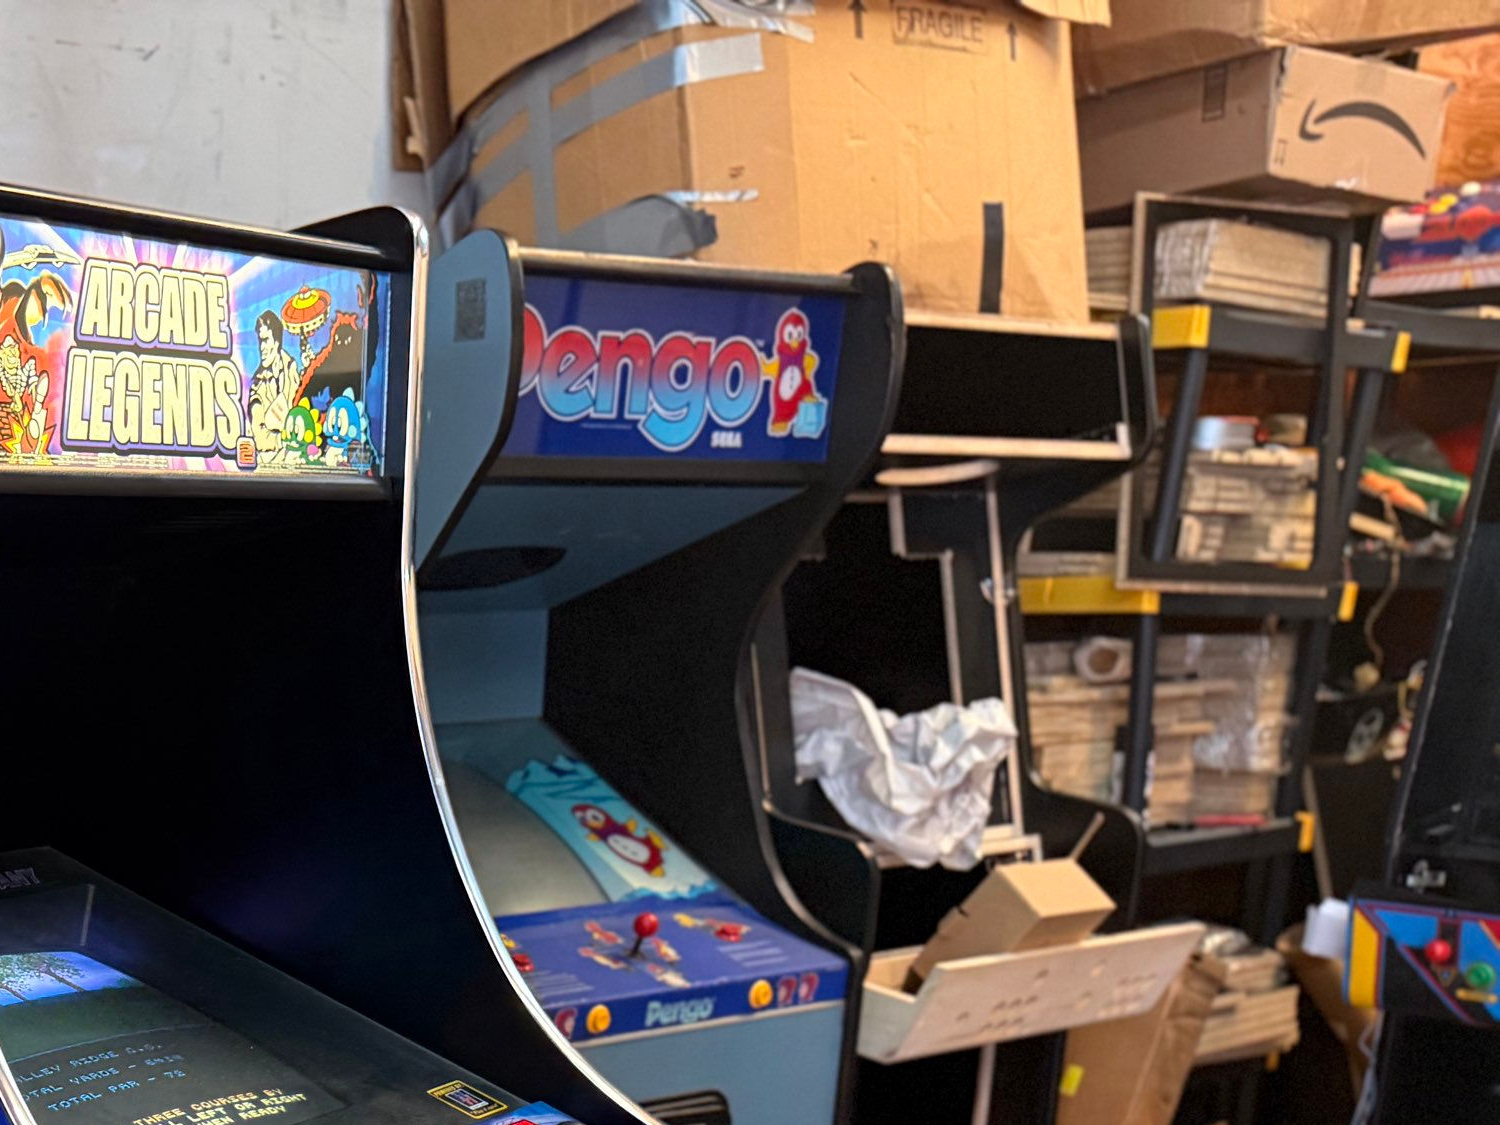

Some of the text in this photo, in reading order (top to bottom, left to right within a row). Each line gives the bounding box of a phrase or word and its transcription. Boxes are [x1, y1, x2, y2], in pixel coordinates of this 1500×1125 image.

[896, 6, 984, 44] FRAGILE
[78, 260, 231, 352] ARCADE
[64, 348, 243, 452] LEGENDS
[711, 431, 742, 448] SEGA
[645, 997, 714, 1027] Pengo
[69, 1050, 119, 1068] RIDGE
[69, 1067, 120, 1085] YARDS
[48, 1092, 102, 1112] TOTAL
[108, 1080, 140, 1094] PAR
[187, 1107, 227, 1123] LEFT
[234, 1101, 256, 1112] OR
[261, 1093, 307, 1107] RIGHT
[191, 1092, 258, 1112] COURSES
[263, 1088, 283, 1098] BY
[238, 1105, 287, 1120] READY
